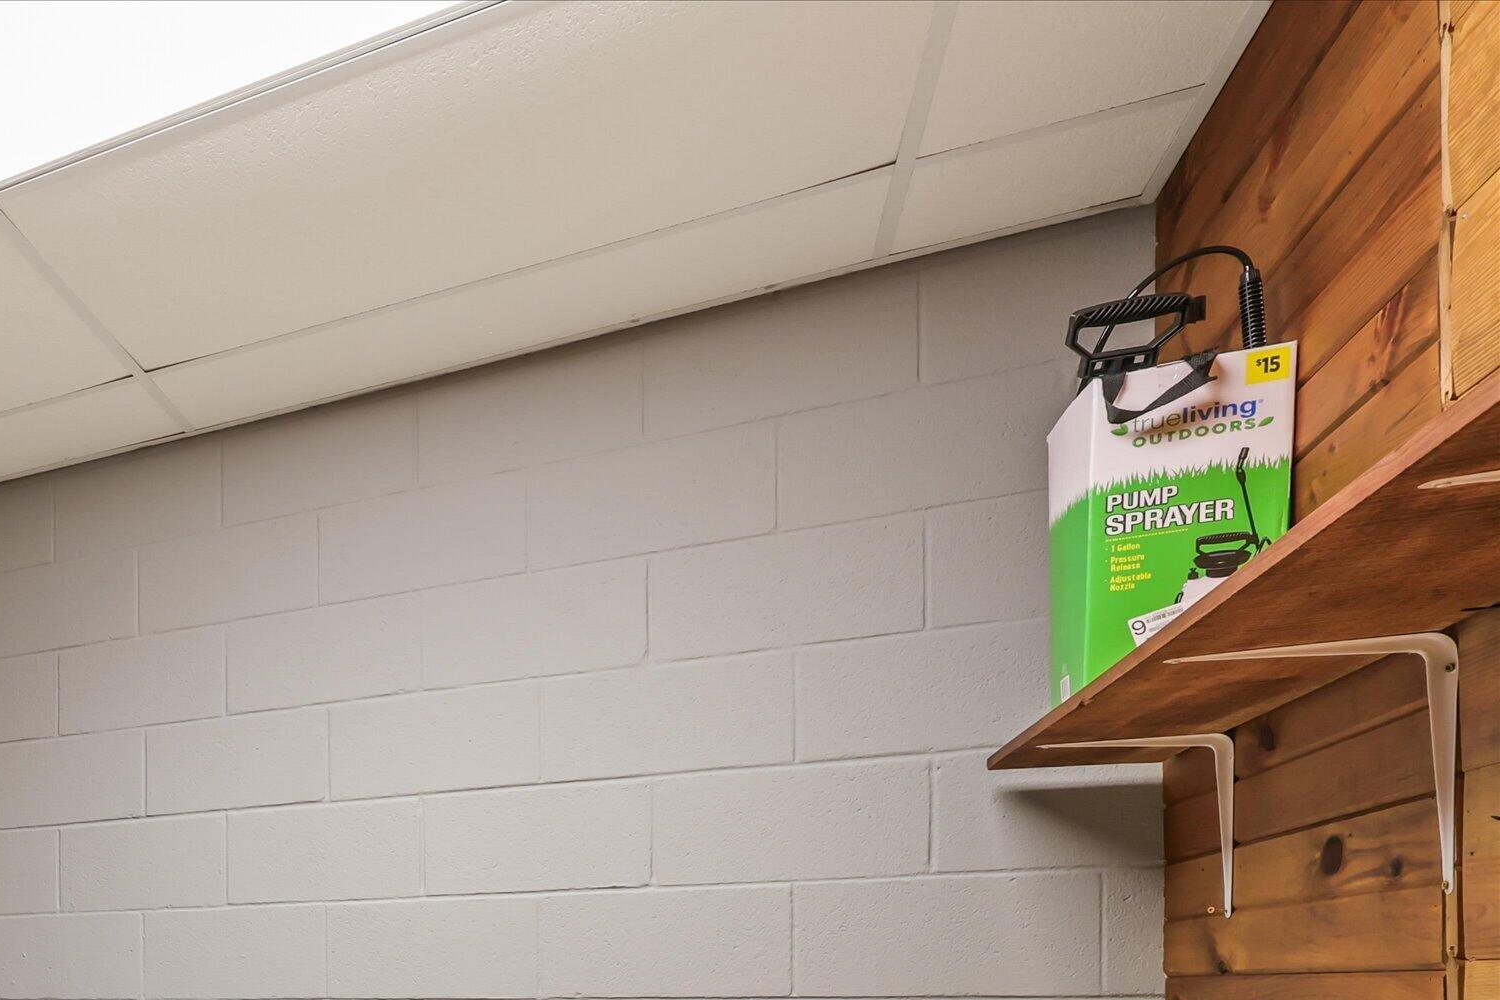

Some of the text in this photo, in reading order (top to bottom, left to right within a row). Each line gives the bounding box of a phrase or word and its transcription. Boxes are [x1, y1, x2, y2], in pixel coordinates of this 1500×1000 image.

[1255, 355, 1281, 374] $15
[1132, 417, 1257, 448] OUTDOORS
[1105, 484, 1180, 513] PUMP
[1105, 498, 1235, 537] SPRAYER
[1117, 542, 1141, 552] Gallon
[1110, 554, 1145, 564] Pressure
[1110, 562, 1141, 572] Release
[1110, 572, 1152, 585] Adjustable
[1110, 582, 1136, 592] Nozzle
